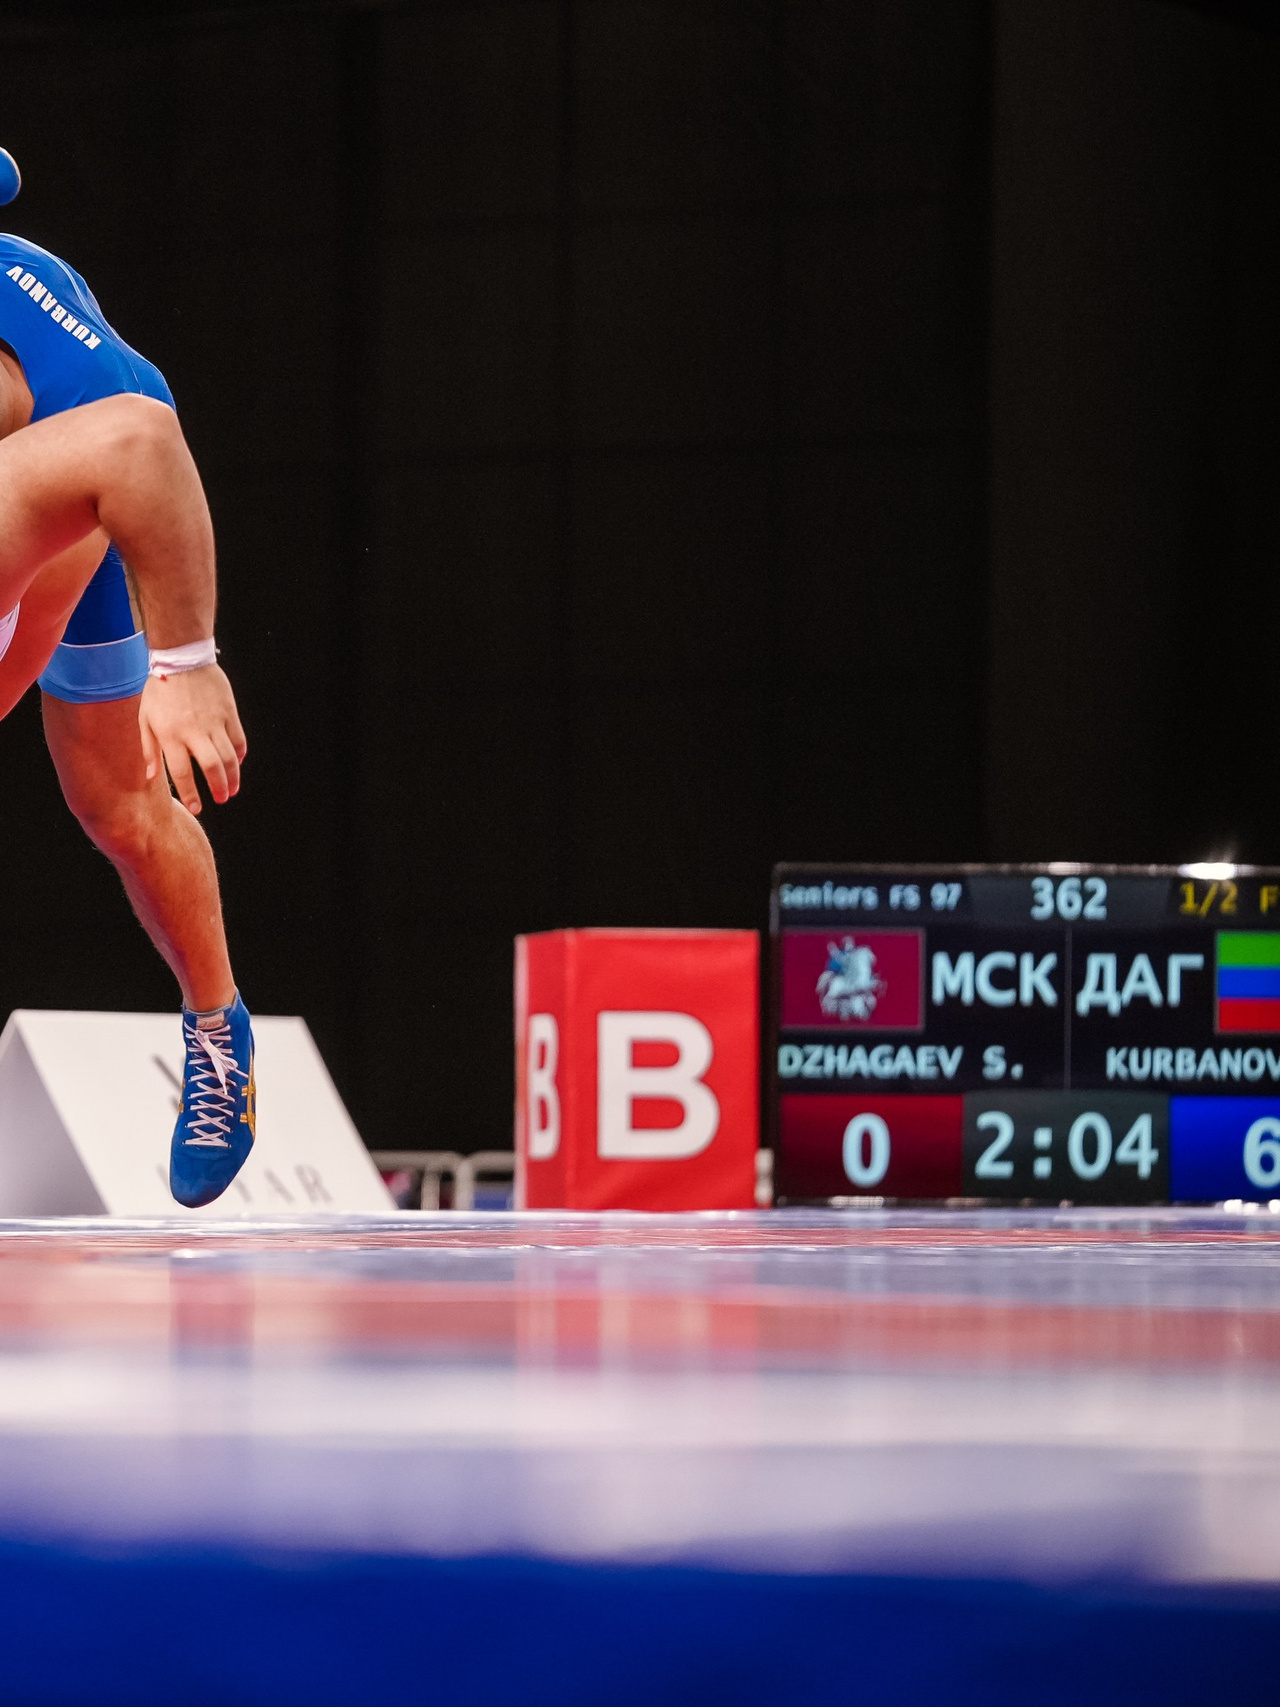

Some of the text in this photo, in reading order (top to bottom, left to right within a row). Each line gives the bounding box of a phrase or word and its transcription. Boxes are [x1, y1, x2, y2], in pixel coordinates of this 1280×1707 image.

[5, 265, 102, 350] KURBANOV
[780, 880, 963, 911] Seniors FS 97
[1030, 876, 1108, 920] 362
[1179, 881, 1238, 918] 1/2
[931, 951, 1058, 1007] МСК
[1075, 952, 1205, 1016] ДАГ
[528, 1013, 561, 1161] B
[596, 1010, 720, 1161] B
[777, 1044, 1024, 1080] DZHAGAEV S.
[842, 1112, 891, 1187] 0
[974, 1110, 1159, 1180] 2:04
[1242, 1116, 1280, 1189] 6
